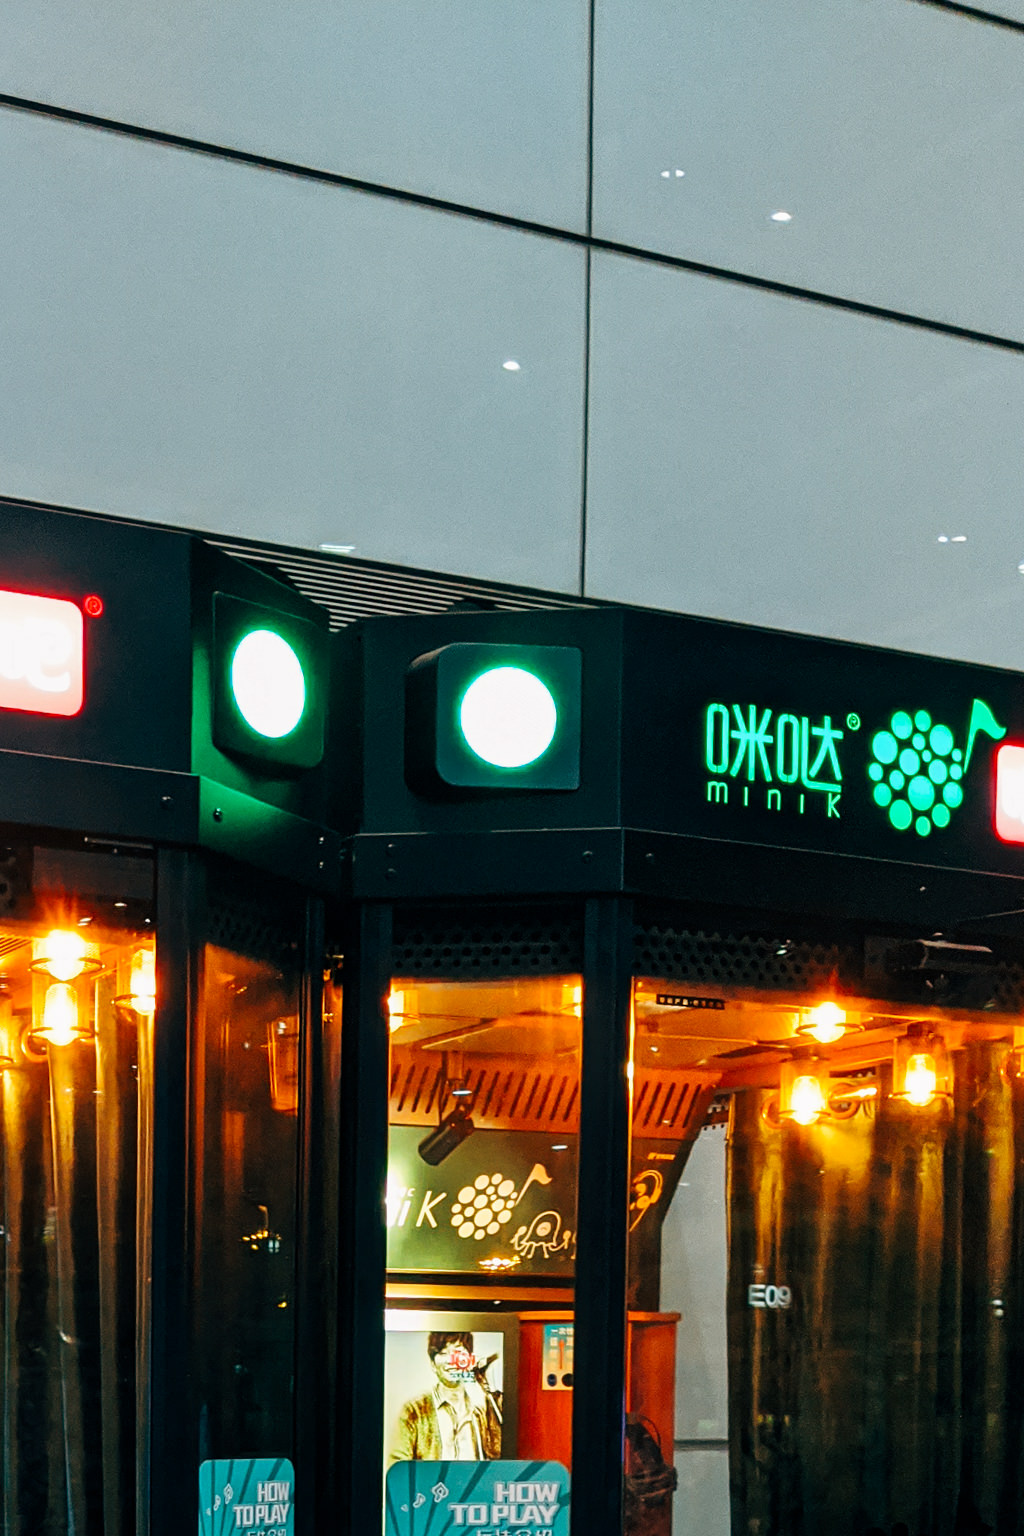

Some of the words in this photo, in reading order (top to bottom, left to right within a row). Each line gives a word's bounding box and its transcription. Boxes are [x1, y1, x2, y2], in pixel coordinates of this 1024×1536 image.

[747, 1284, 792, 1309] E09
[257, 1481, 290, 1504] HOW
[494, 1481, 560, 1504] HOW
[233, 1504, 255, 1528] TO
[255, 1503, 290, 1527] PLAY
[449, 1503, 490, 1526] TO
[490, 1503, 560, 1526] PLAY
